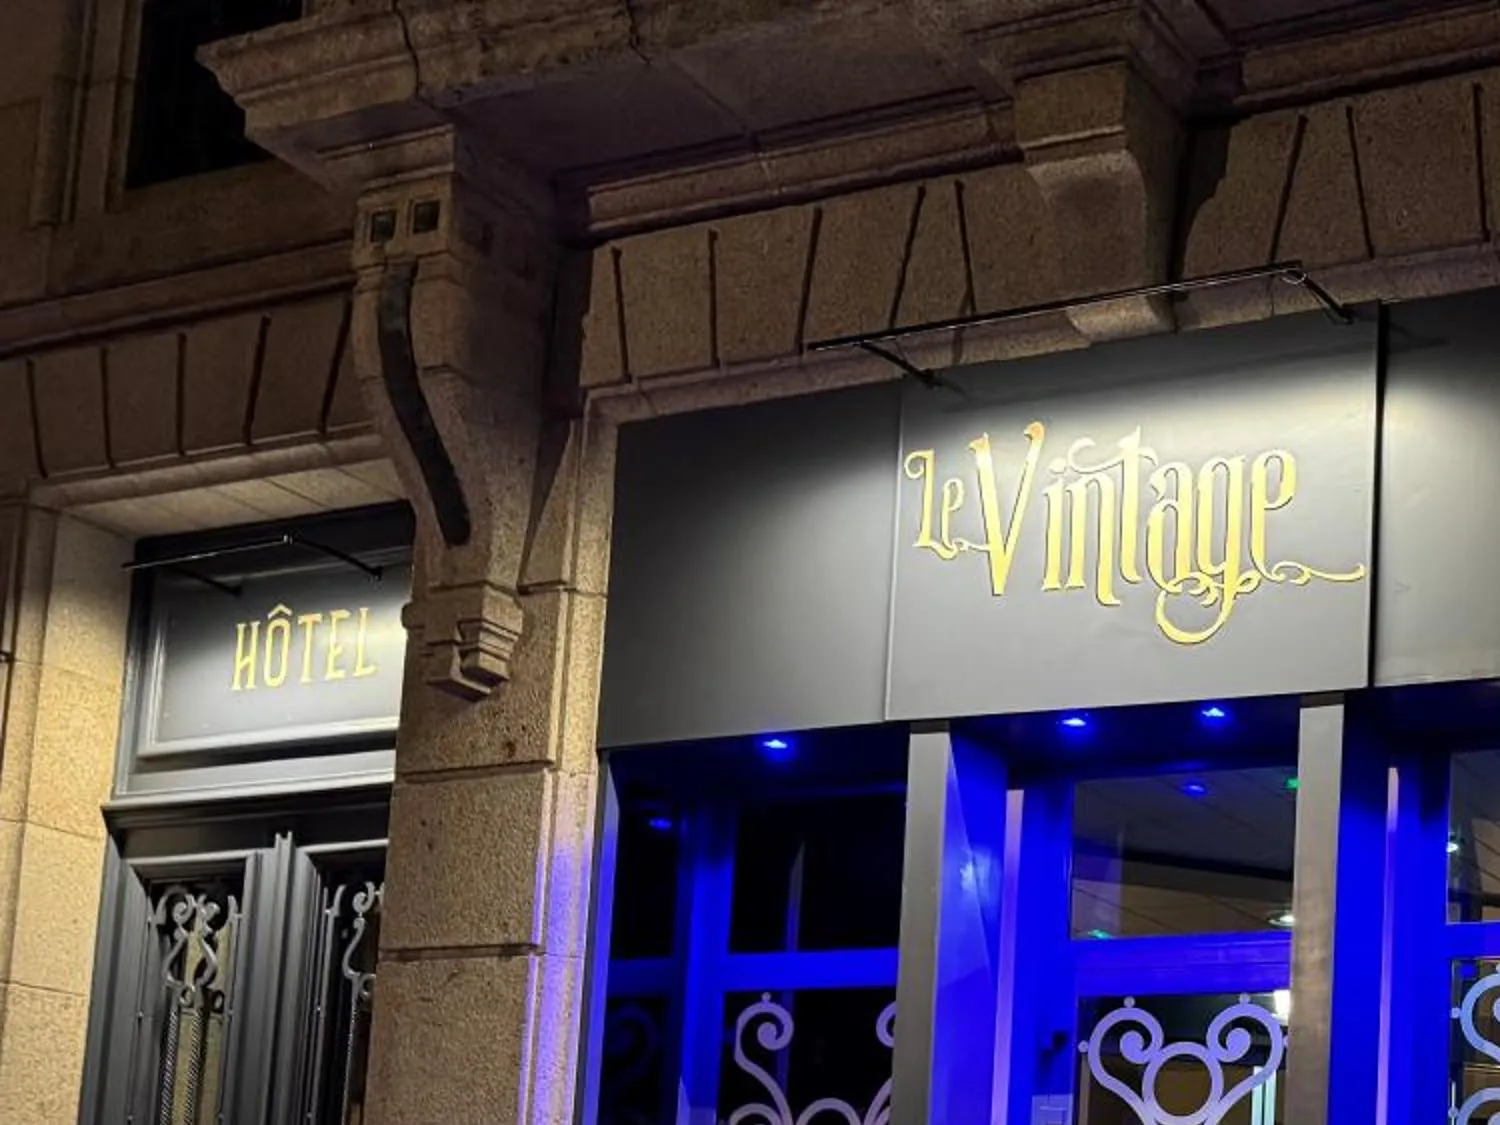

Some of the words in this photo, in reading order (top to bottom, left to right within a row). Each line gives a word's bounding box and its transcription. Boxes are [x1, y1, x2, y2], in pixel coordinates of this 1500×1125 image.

[903, 448, 982, 560] Le
[969, 420, 1367, 645] Vintage
[230, 602, 380, 691] HÔTEL
